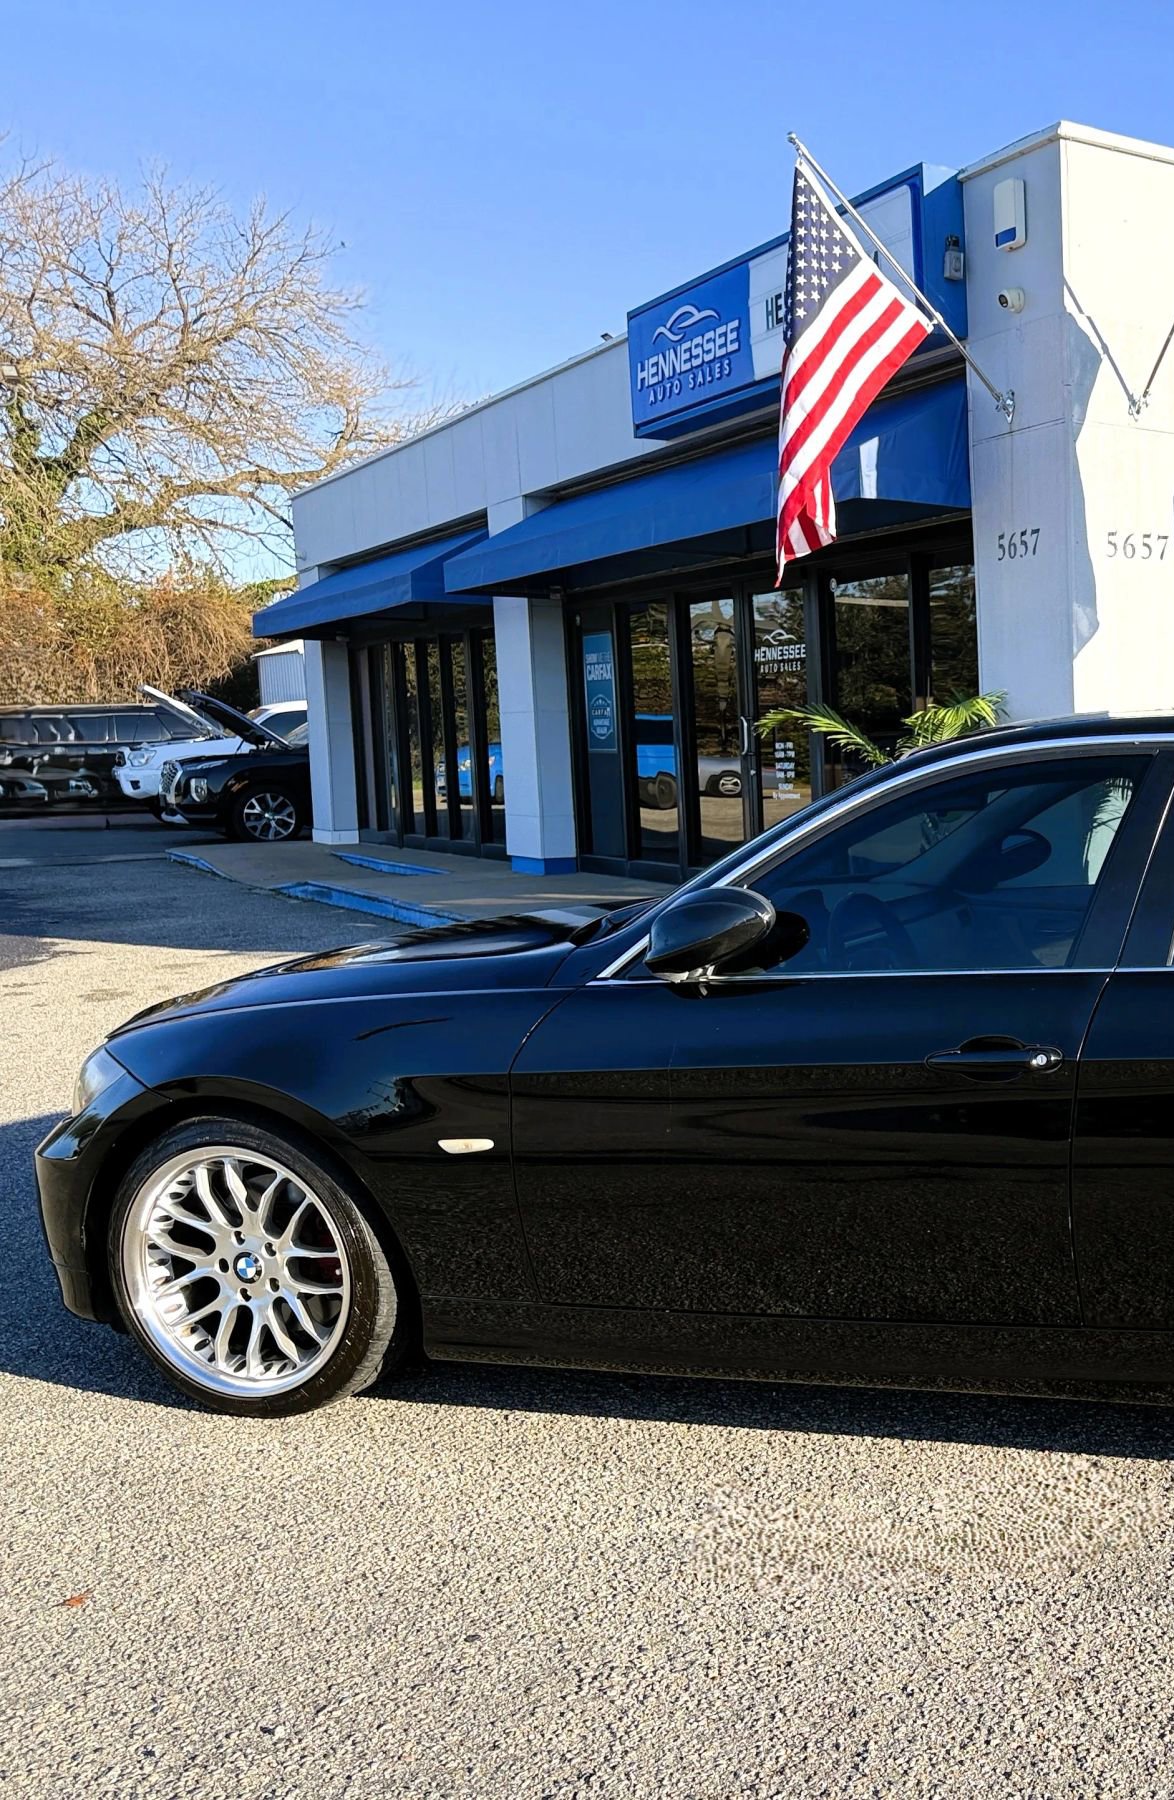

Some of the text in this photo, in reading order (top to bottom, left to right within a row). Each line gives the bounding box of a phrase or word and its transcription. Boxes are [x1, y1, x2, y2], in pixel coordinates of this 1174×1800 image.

[637, 319, 739, 390] HENNESSEE
[648, 358, 731, 405] AUTO SALES
[997, 528, 1041, 561] 5657
[1106, 531, 1169, 561] 5657
[754, 644, 806, 662] HENNESSEE
[760, 661, 801, 673] AUTO SALES
[586, 663, 612, 680] CARFAX
